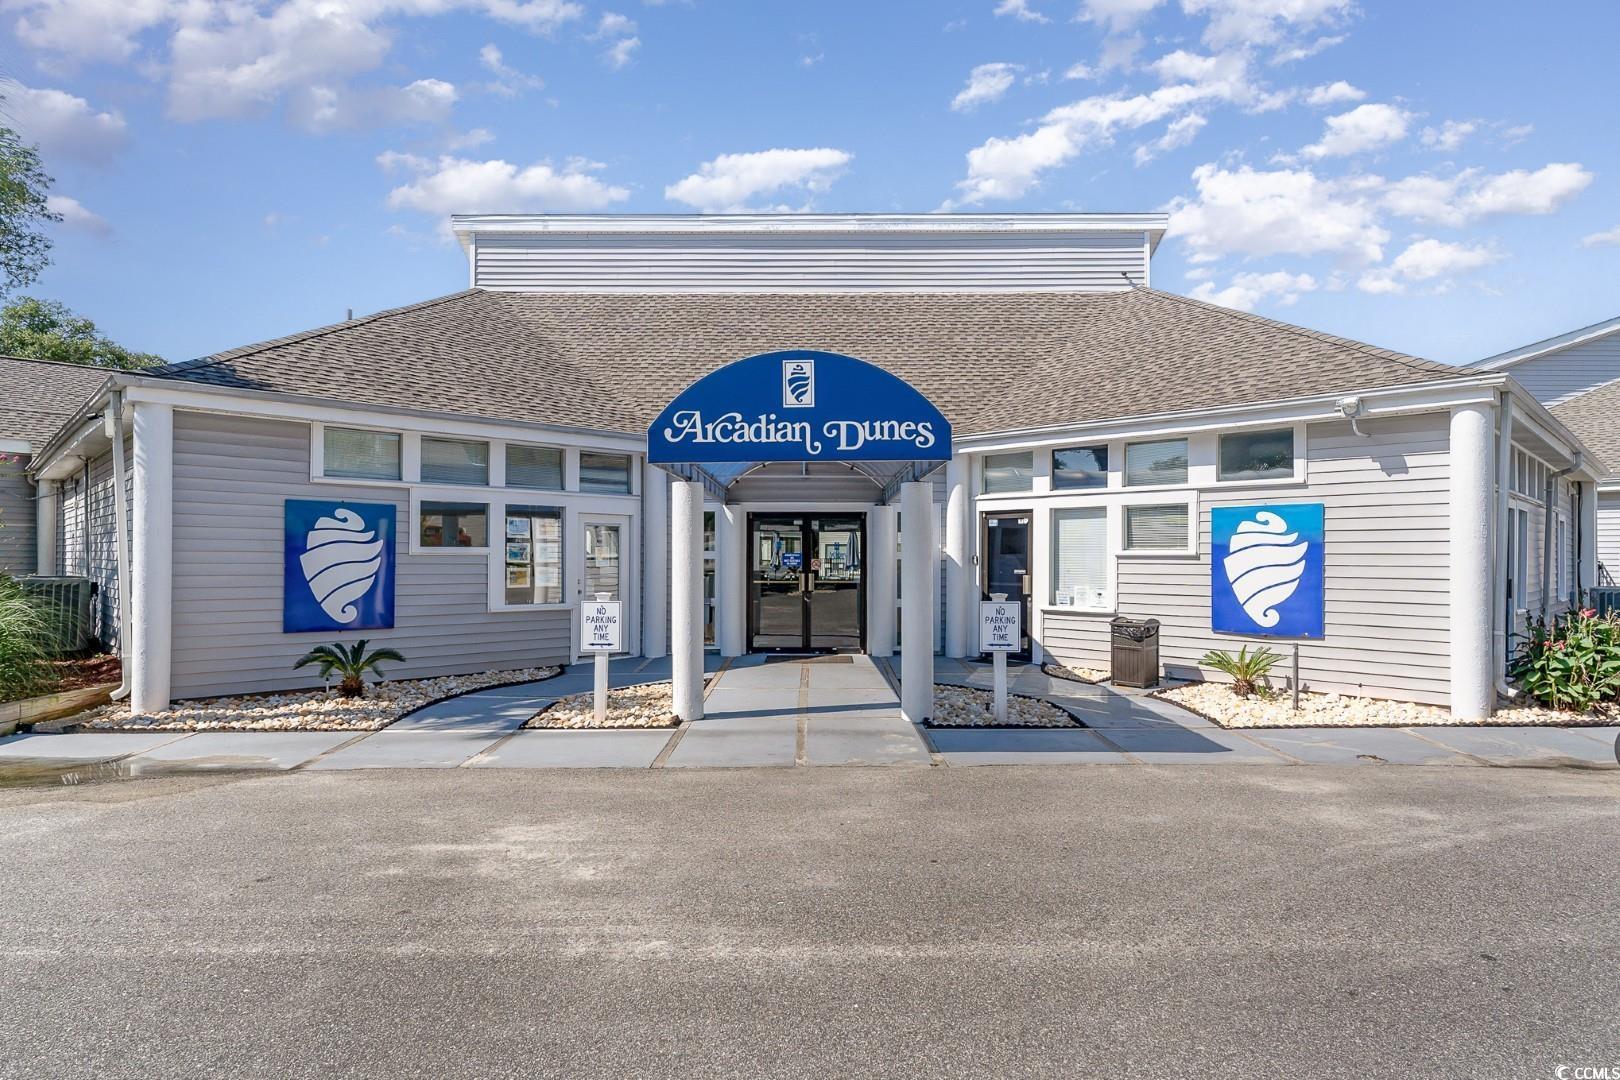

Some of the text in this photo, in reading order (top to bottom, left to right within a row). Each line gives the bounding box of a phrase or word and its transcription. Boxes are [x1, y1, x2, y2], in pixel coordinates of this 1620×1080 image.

[664, 410, 935, 455] Arcadian Dunes
[596, 607, 607, 616] NO
[995, 607, 1006, 616] NO
[585, 616, 617, 624] PARKING
[984, 616, 1016, 624] PARKING
[593, 624, 609, 633] ANY
[992, 625, 1008, 633] ANY
[593, 633, 610, 641] TIME
[992, 633, 1009, 641] TIME
